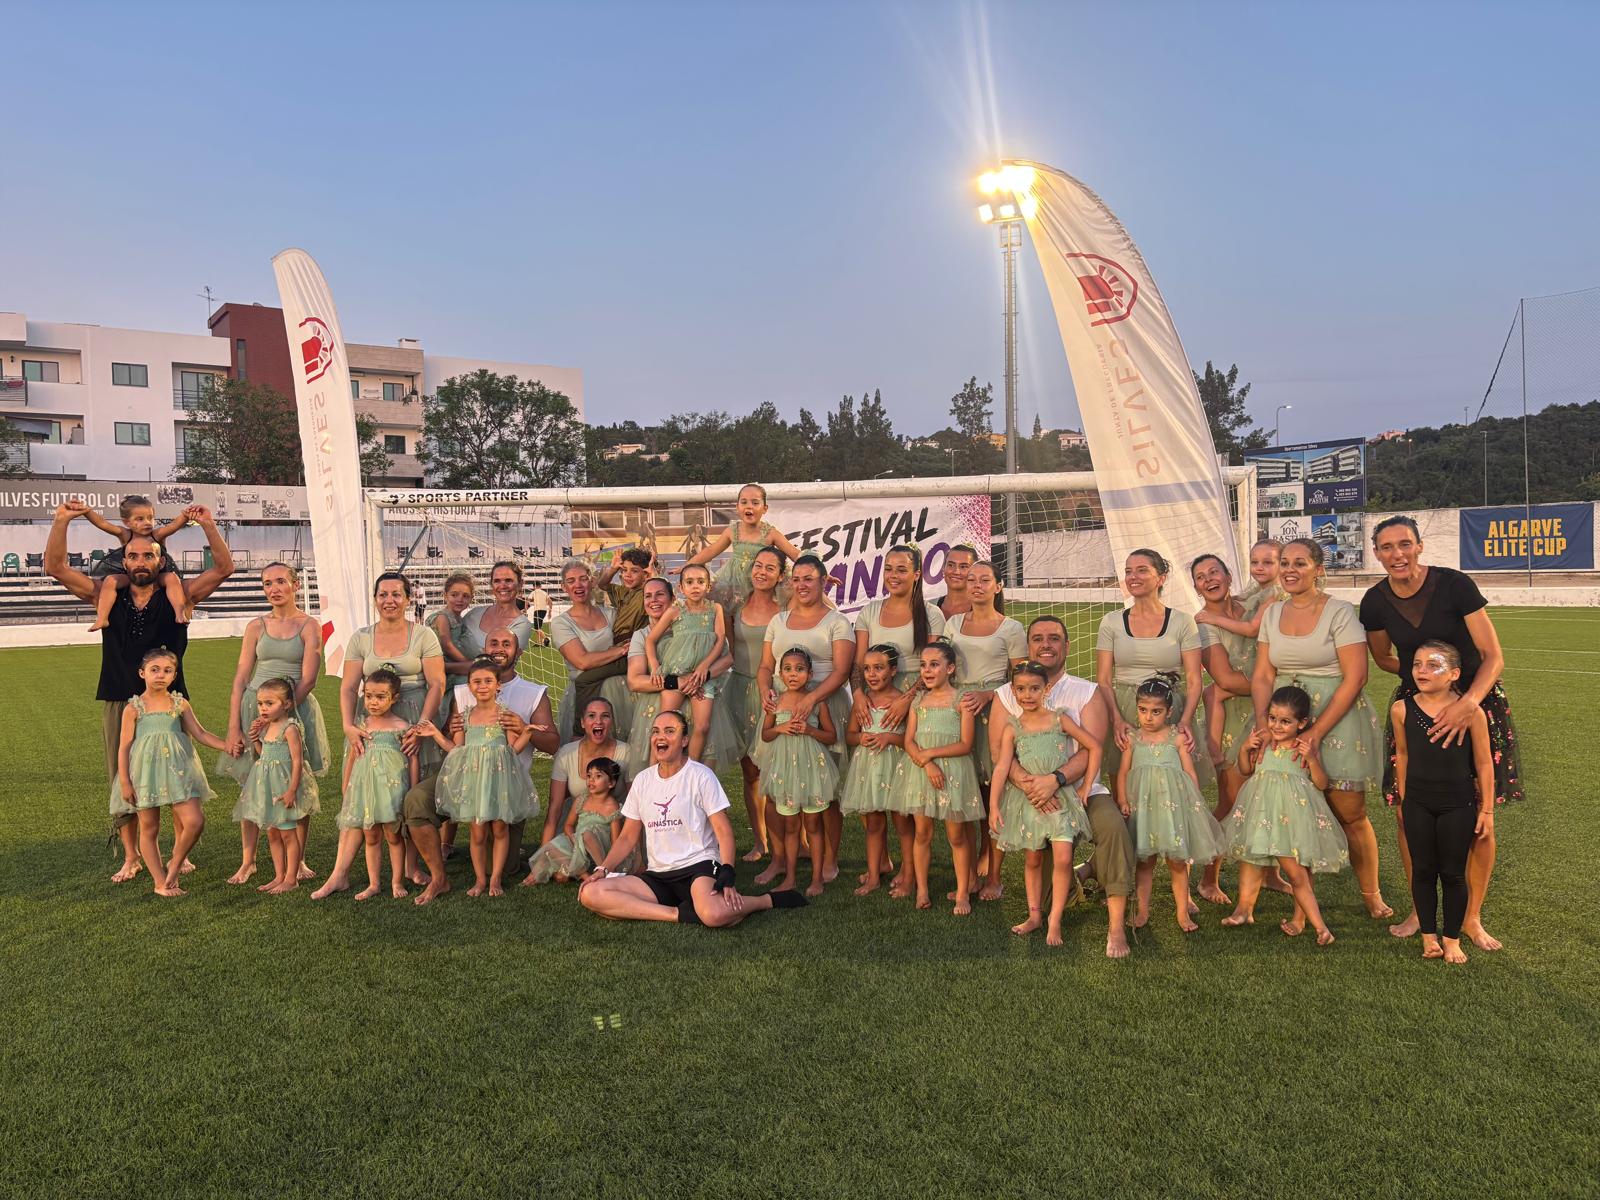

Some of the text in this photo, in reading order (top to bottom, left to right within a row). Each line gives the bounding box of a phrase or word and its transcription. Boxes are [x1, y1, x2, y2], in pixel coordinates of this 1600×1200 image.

[0, 492, 40, 508] ILVES
[408, 491, 529, 504] SPORTS PARTNER
[1488, 518, 1562, 538] ALGARVE
[1484, 537, 1567, 556] ELITE CUP
